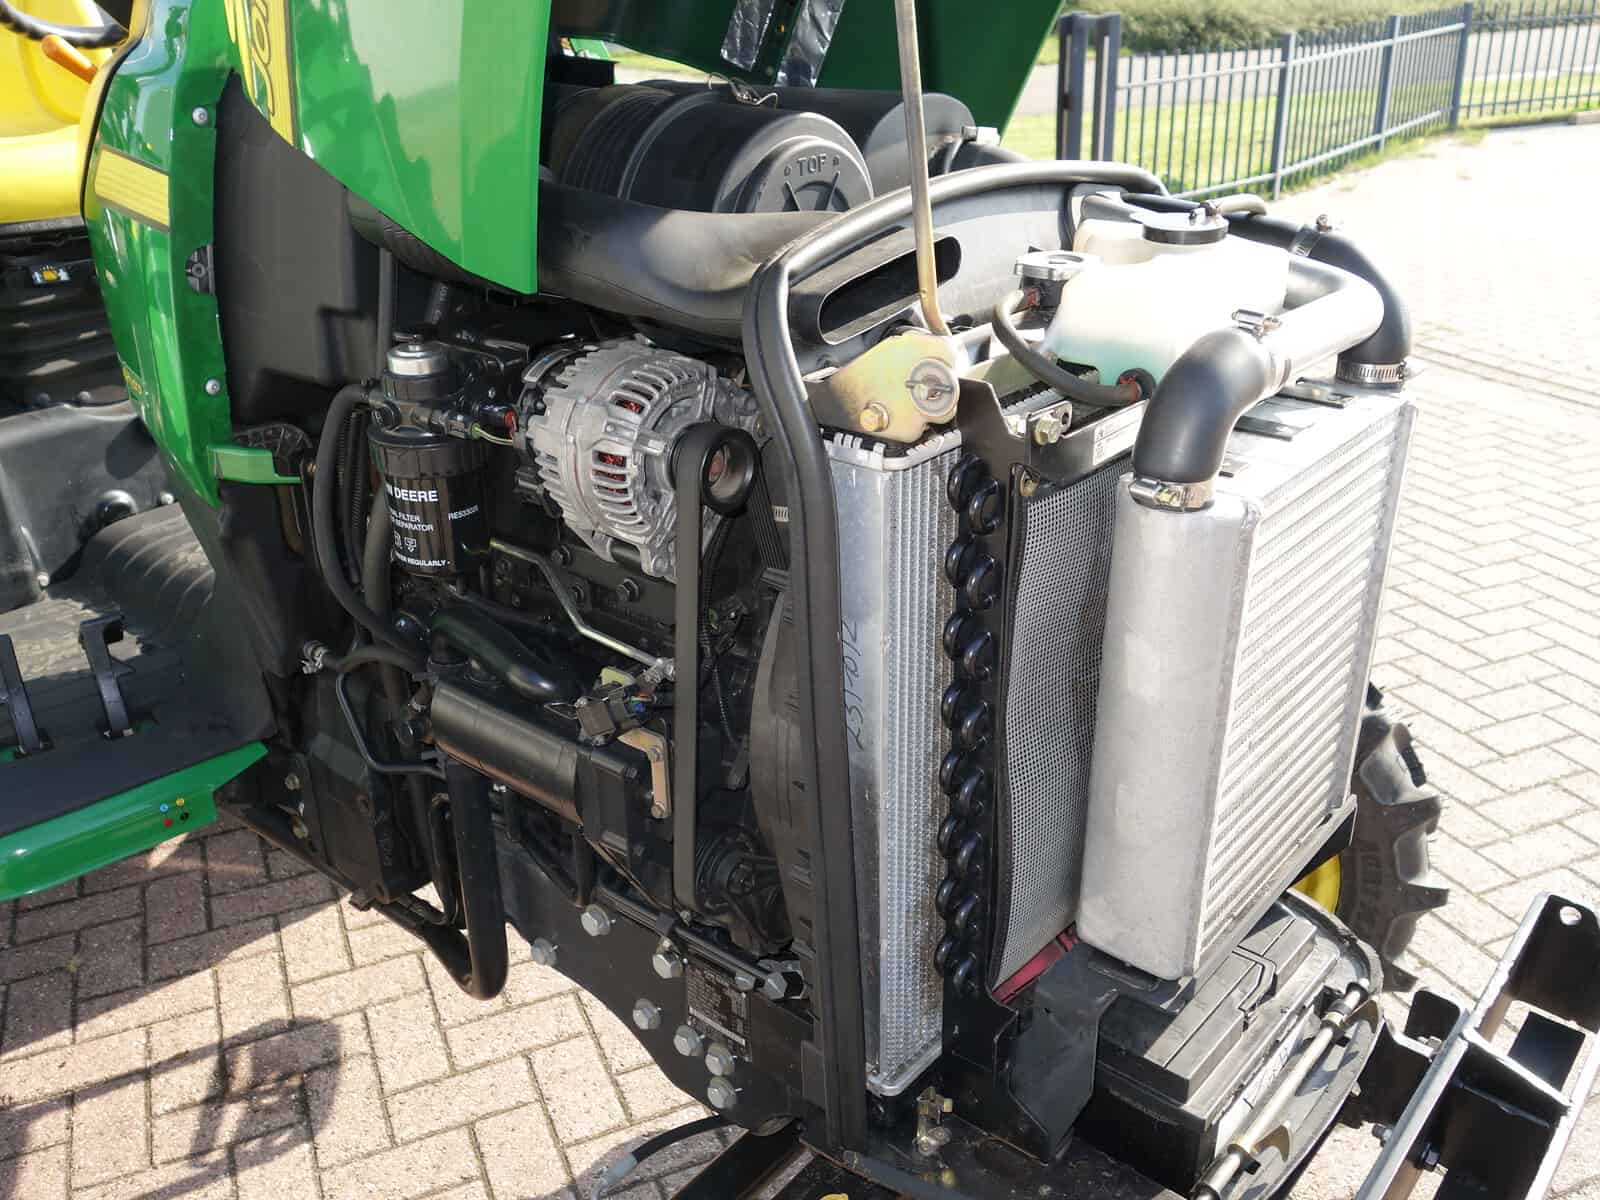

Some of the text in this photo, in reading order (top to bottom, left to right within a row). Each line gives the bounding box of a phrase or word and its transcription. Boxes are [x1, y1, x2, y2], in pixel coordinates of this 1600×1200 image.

[394, 486, 439, 502] DEERE
[399, 511, 421, 523] FILTER
[407, 557, 447, 567] REGULARLY
